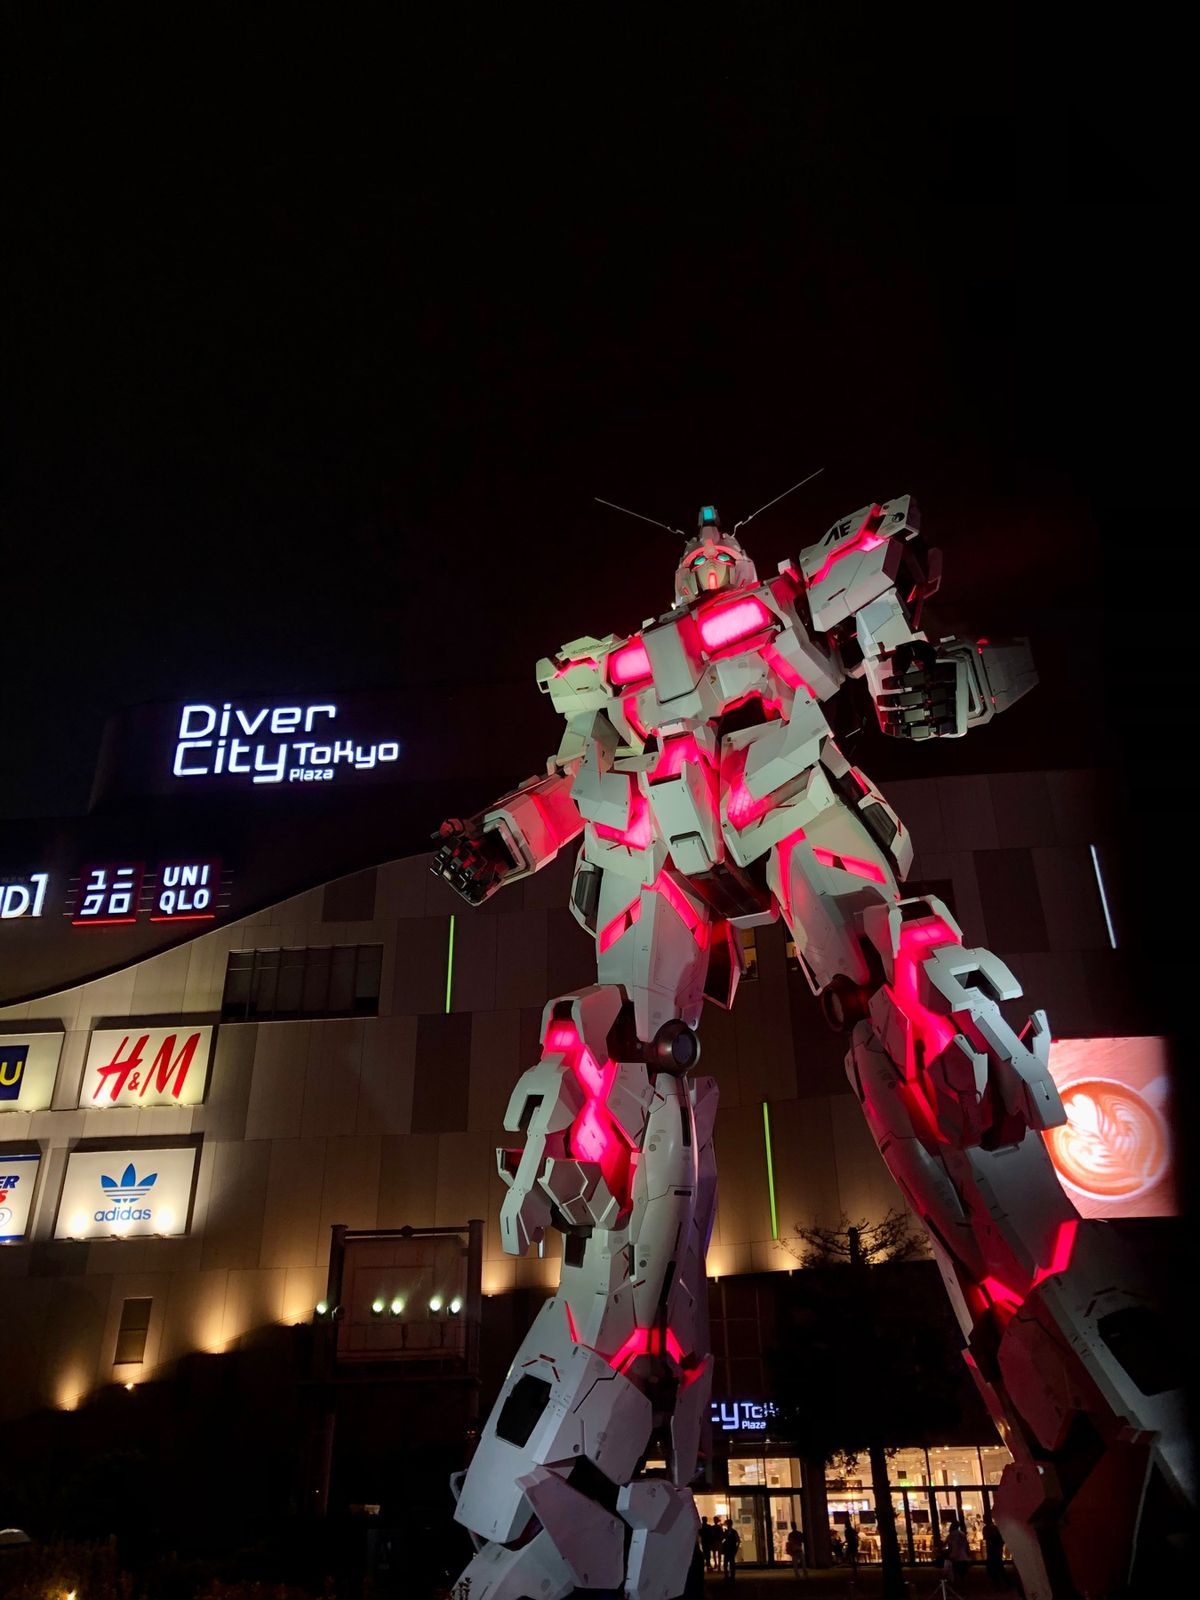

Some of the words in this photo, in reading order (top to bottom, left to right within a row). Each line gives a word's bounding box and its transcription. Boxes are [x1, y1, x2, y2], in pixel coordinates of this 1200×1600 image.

[179, 703, 336, 739] Diver
[173, 739, 287, 784] City
[289, 768, 334, 783] Plaza
[86, 869, 133, 891] ユニ
[163, 865, 209, 887] UNI
[0, 873, 49, 918] D1
[80, 893, 131, 915] クロ
[159, 889, 209, 915] QLO
[92, 1032, 201, 1102] H&M
[94, 1206, 152, 1223] adidas
[741, 1420, 767, 1430] Plaza
